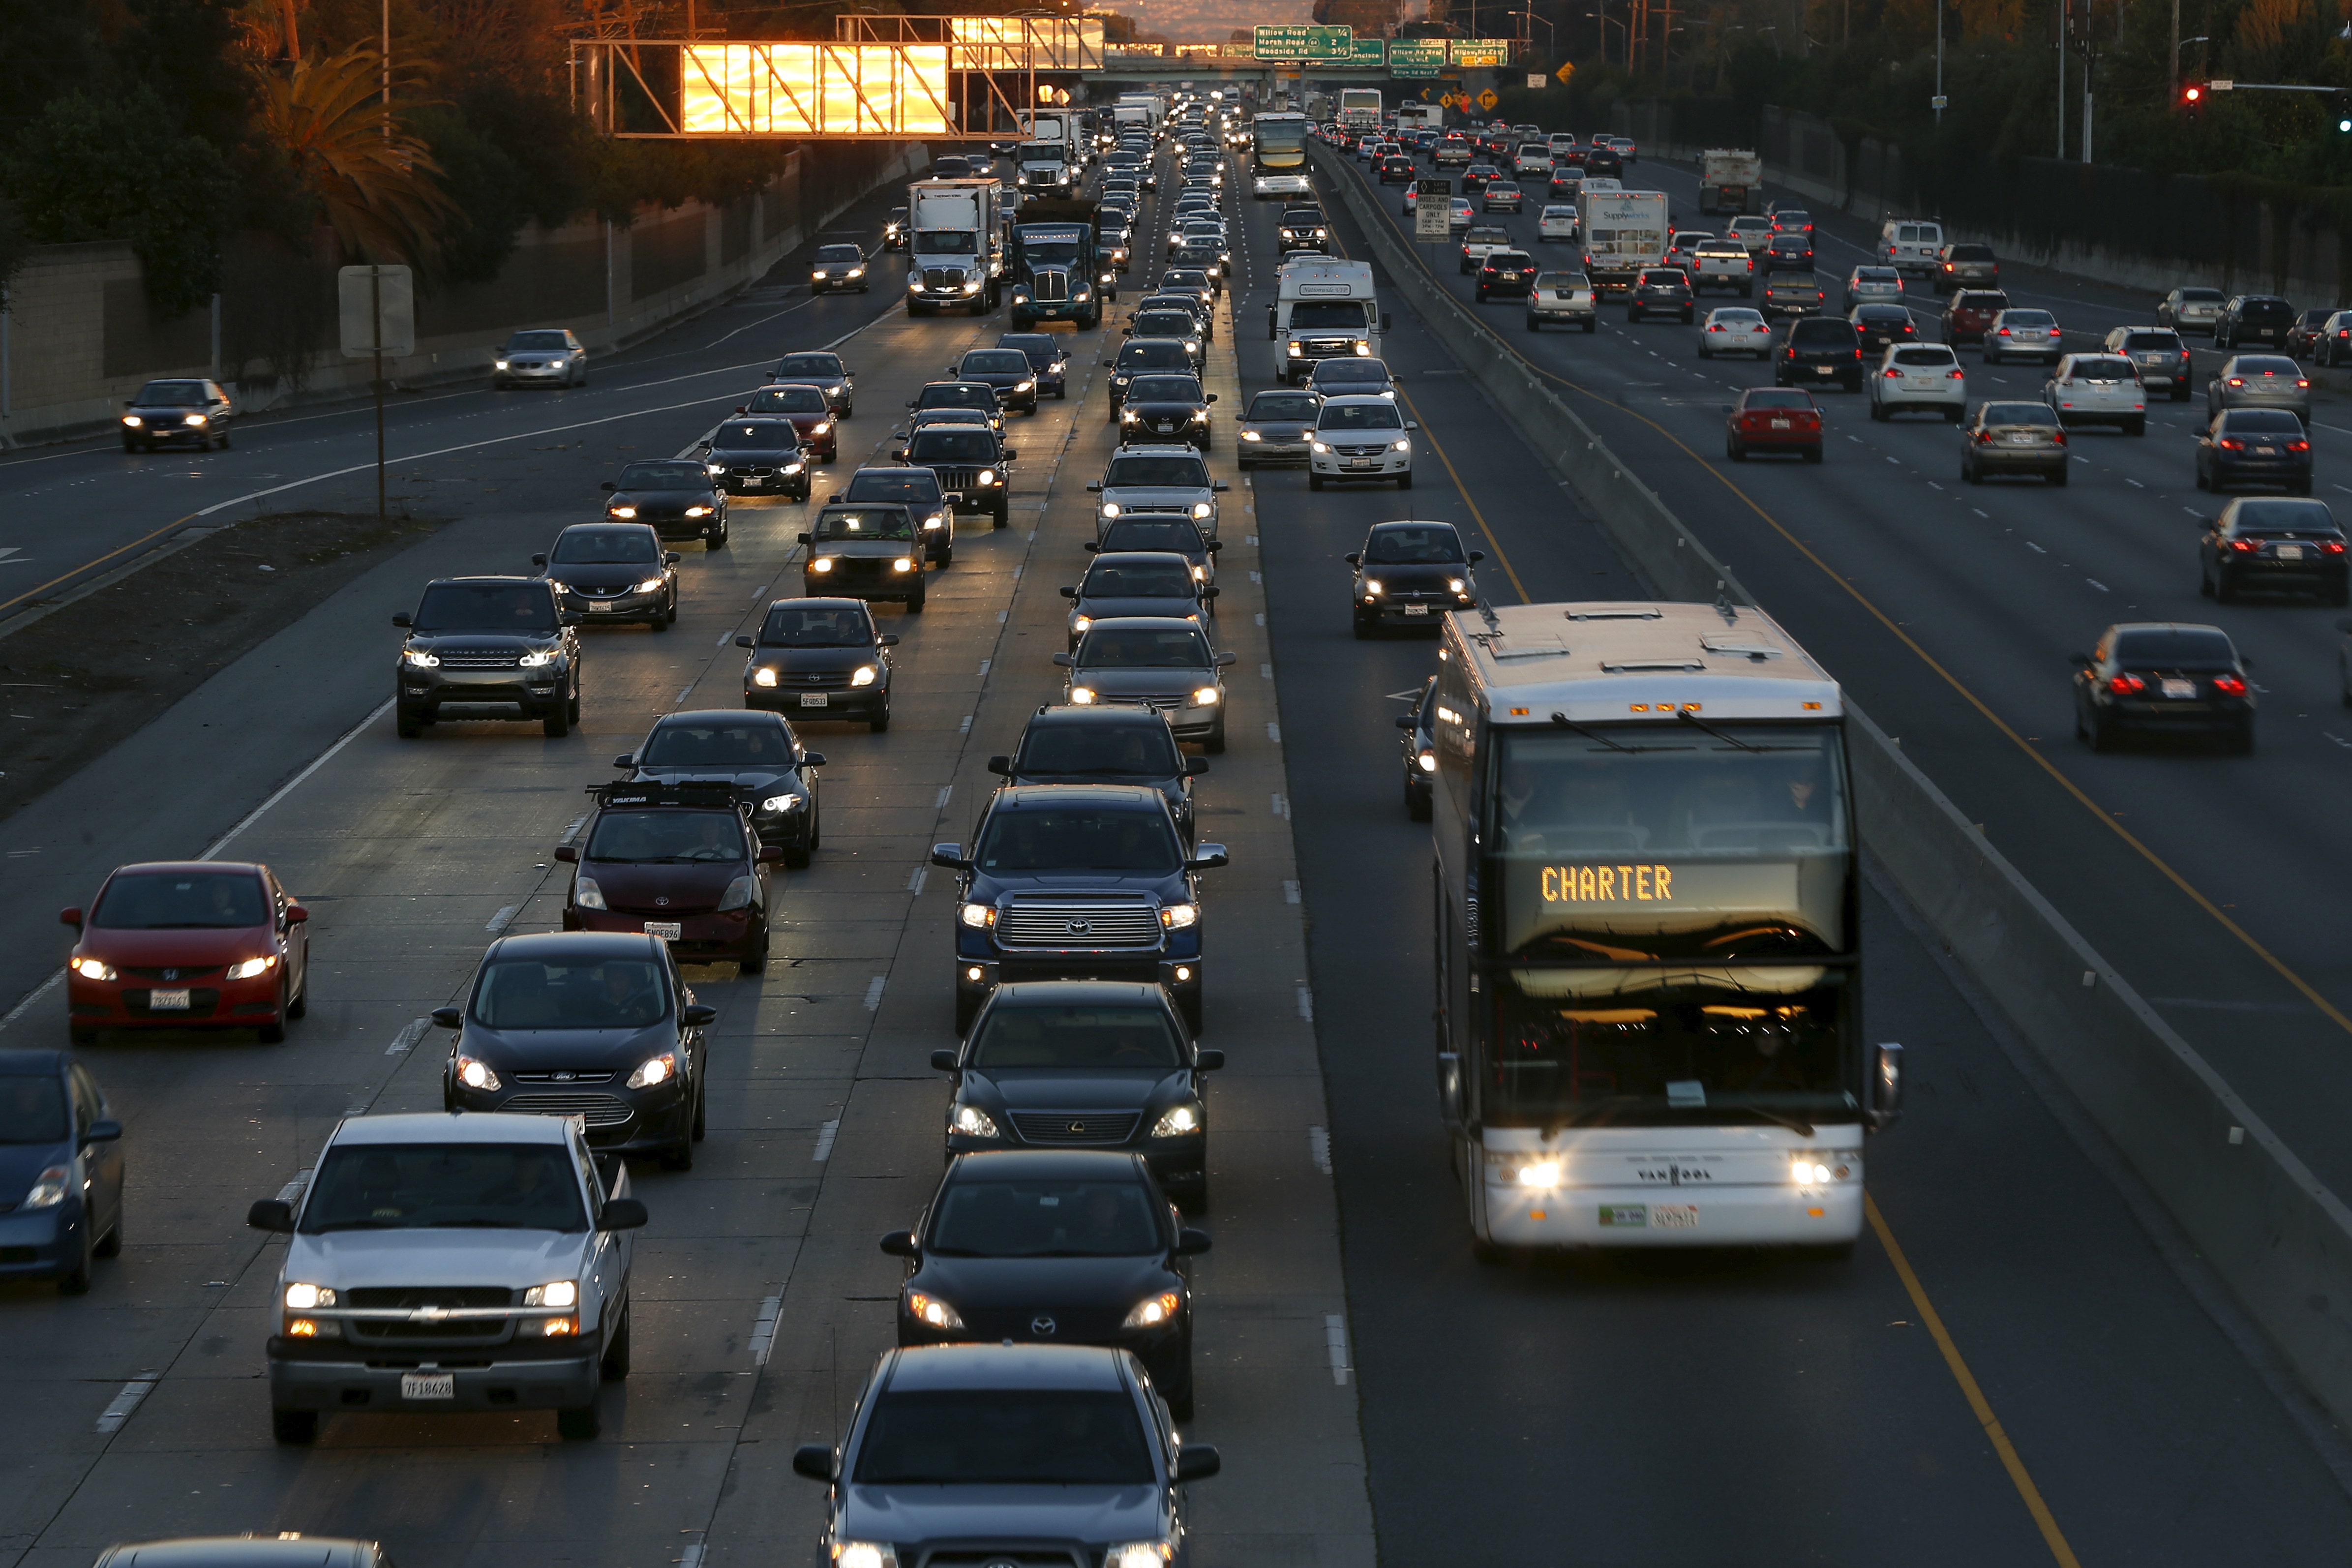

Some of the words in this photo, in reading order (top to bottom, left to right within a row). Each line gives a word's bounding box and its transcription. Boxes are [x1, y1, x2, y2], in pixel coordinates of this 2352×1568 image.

[1603, 211, 1649, 220] Supplyworks
[1541, 865, 1672, 902] CHARTER
[405, 1381, 452, 1396] 7F18628
